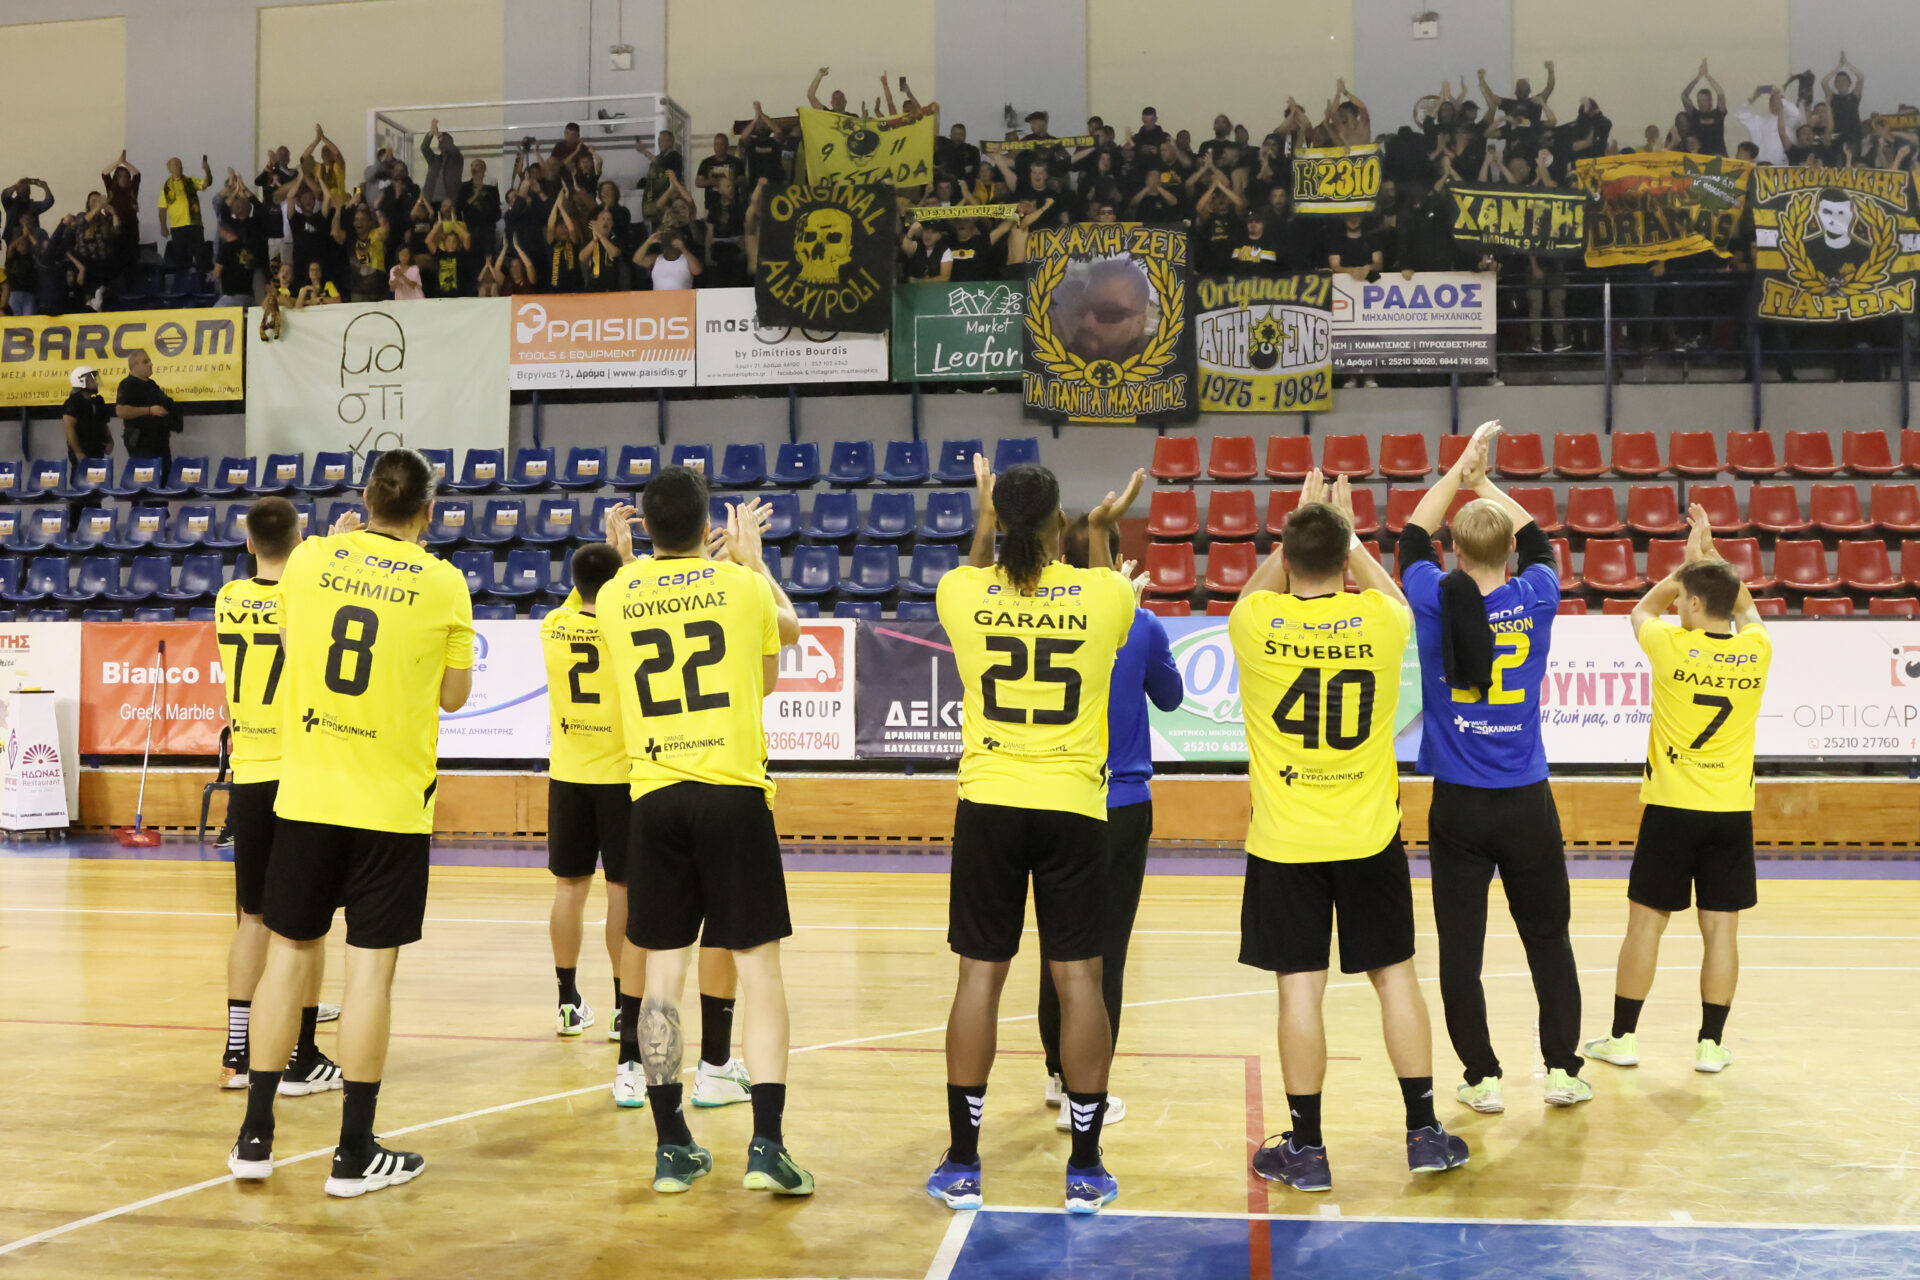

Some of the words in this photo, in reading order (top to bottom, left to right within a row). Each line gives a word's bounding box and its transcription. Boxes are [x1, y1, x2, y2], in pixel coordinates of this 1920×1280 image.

[1757, 166, 1909, 210] ΝΙΚΟΛΑΚΗΣ
[770, 183, 886, 236] ORIGINAL
[1453, 193, 1584, 239] XANTHI
[1026, 225, 1123, 262] ΜΙΧΑΛΗ
[1132, 228, 1188, 263] ΖΕΙΣ
[1198, 274, 1298, 311] Original
[1303, 274, 1332, 306] 21
[1363, 284, 1482, 310] ΡΑΔΟΣ
[1761, 280, 1915, 319] ΠΑΡΩΝ
[966, 317, 1014, 334] Market
[1362, 311, 1429, 322] ΜΗΧΑΝΟΛΟΓΟΣ
[1430, 311, 1483, 321] ΜΗΧΑΝΙΚΟΣ
[547, 317, 690, 343] PAISIDIS
[1200, 308, 1330, 369] ATHENS
[1, 319, 235, 363] BARCOM
[735, 349, 747, 358] by
[751, 347, 801, 358] Dimitrios
[806, 345, 848, 356] Bourdis
[1355, 341, 1411, 350] ΚΛΙΜΑΤΙΣΜΟΣ
[518, 351, 557, 361] TOOLS
[569, 348, 637, 360] EQUIPMENT
[932, 336, 1023, 373] Leofor
[32, 367, 71, 378] ΑΤΟΜΙΚ
[156, 363, 233, 375] ΕΡΓΑΖΟΜΕΝΩΝ
[516, 369, 557, 380] Βεργίνας
[559, 369, 574, 379] 73,
[575, 368, 605, 379] Δράμα
[612, 367, 688, 378] www.paisidis.gr
[1047, 383, 1108, 414] ΠΑΝΤΑ
[1108, 373, 1187, 417] ΜΑΧΗΤΗΣ
[1201, 373, 1253, 408] 1975
[1274, 372, 1329, 409] 1982
[319, 572, 420, 607] SCHMIDT
[622, 591, 728, 620] ΚΟΥΚΟΥΛΑΣ
[982, 598, 1082, 607] RENTALS
[974, 610, 1087, 631] GARAIN
[0, 634, 30, 649] ΤΗΣ
[325, 604, 379, 697] 8
[1264, 640, 1374, 660] STUEBER
[102, 661, 200, 684] Bianco
[217, 632, 285, 706] 77
[568, 642, 601, 705] 2
[630, 619, 731, 718] 22
[1673, 668, 1762, 690] ΒΛΑΣΤΟΣ
[980, 635, 1087, 726] 25
[1540, 672, 1650, 707] ΟΥΝΤΣΙ
[120, 703, 162, 720] Greek
[165, 703, 215, 720] Marble
[779, 700, 842, 718] GROUP
[1271, 667, 1376, 751] 40
[1553, 708, 1579, 725] ζωή
[1582, 711, 1609, 727] μας,
[1625, 709, 1653, 725] τόπο
[321, 718, 377, 739] ΕΥΡΩΚΛΙΝΙΚΗΣ
[468, 727, 514, 736] ΔΗΜΗΤΡΗΣ
[569, 723, 612, 733] ΕΥΡΩΚΛΙΝΙΚΗΣ
[1689, 692, 1734, 750] 7
[663, 737, 726, 752] ΕΥΡΩΚΛΙΝΙΚΗΣ
[763, 731, 840, 750] 936647840
[884, 731, 931, 741] ΔΡΑΜΙΝΗ
[933, 731, 962, 740] ΕΜΠΟ
[1823, 737, 1859, 749] 25210
[1862, 737, 1900, 749] 27760
[1183, 742, 1219, 752] 25210
[21, 769, 60, 779] ΗΔΩΝΑΣ
[22, 778, 61, 786] Restaurant
[1301, 771, 1365, 781] ΕΥΡΩΚΛΙΝΙΚΗΣ
